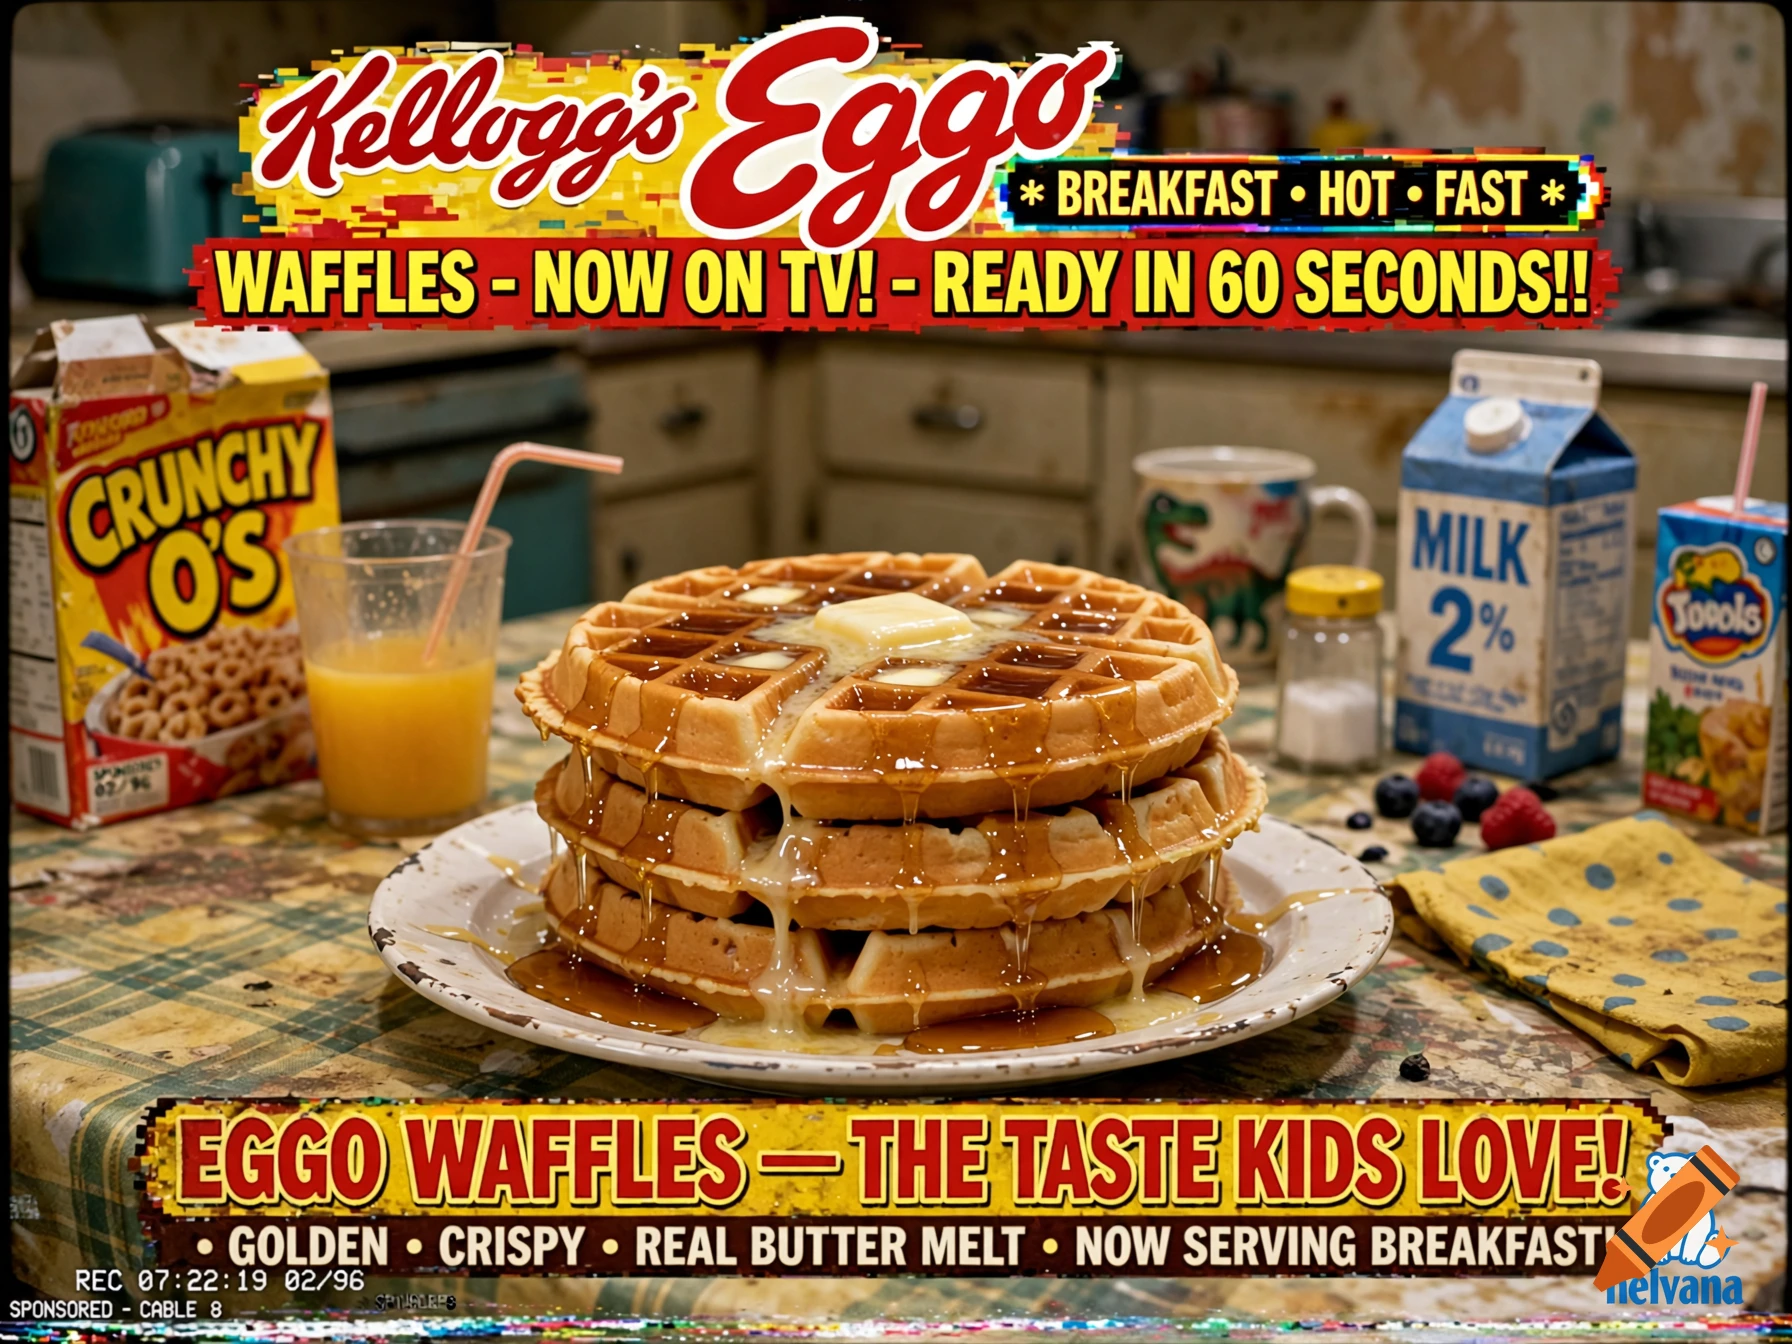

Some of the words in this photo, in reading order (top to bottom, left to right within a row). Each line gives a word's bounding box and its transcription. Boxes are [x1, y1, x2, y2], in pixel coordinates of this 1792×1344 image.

[66, 418, 323, 571] CRUNCHY
[1411, 506, 1531, 587] MILK
[148, 506, 280, 637] O'S
[1427, 584, 1516, 674] 2%
